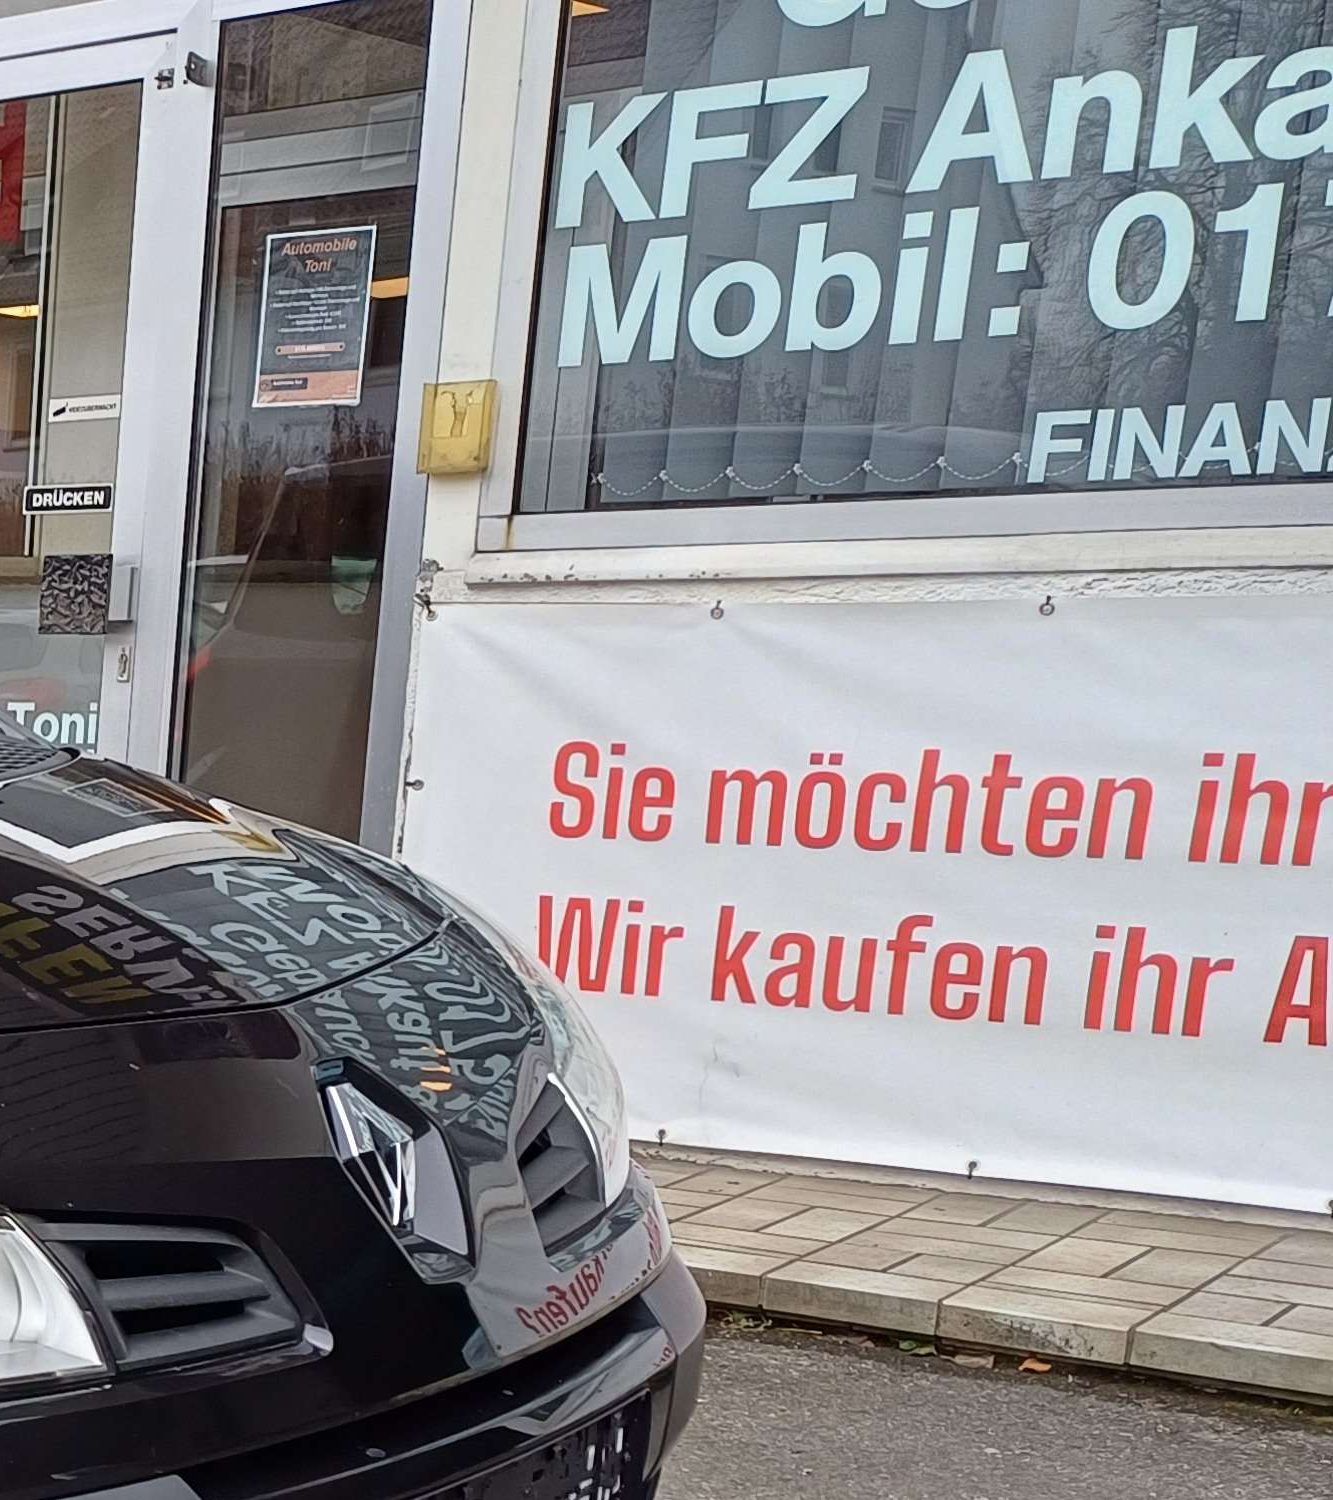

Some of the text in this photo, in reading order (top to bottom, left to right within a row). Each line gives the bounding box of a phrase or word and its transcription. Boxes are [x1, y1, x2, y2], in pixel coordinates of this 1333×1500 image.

[554, 25, 1333, 230] KFZ Anka
[281, 237, 358, 256] Automobile
[556, 181, 1333, 368] Mobil: 01
[1025, 397, 1333, 485] FINAN
[32, 489, 105, 507] DRÜCKEN
[7, 702, 98, 744] Toni
[549, 740, 676, 841] Sie
[704, 747, 1155, 862] möchten
[538, 894, 683, 998] Wir
[710, 904, 1048, 1026] kaufen
[1083, 925, 1235, 1037] ihr
[1263, 936, 1329, 1046] A
